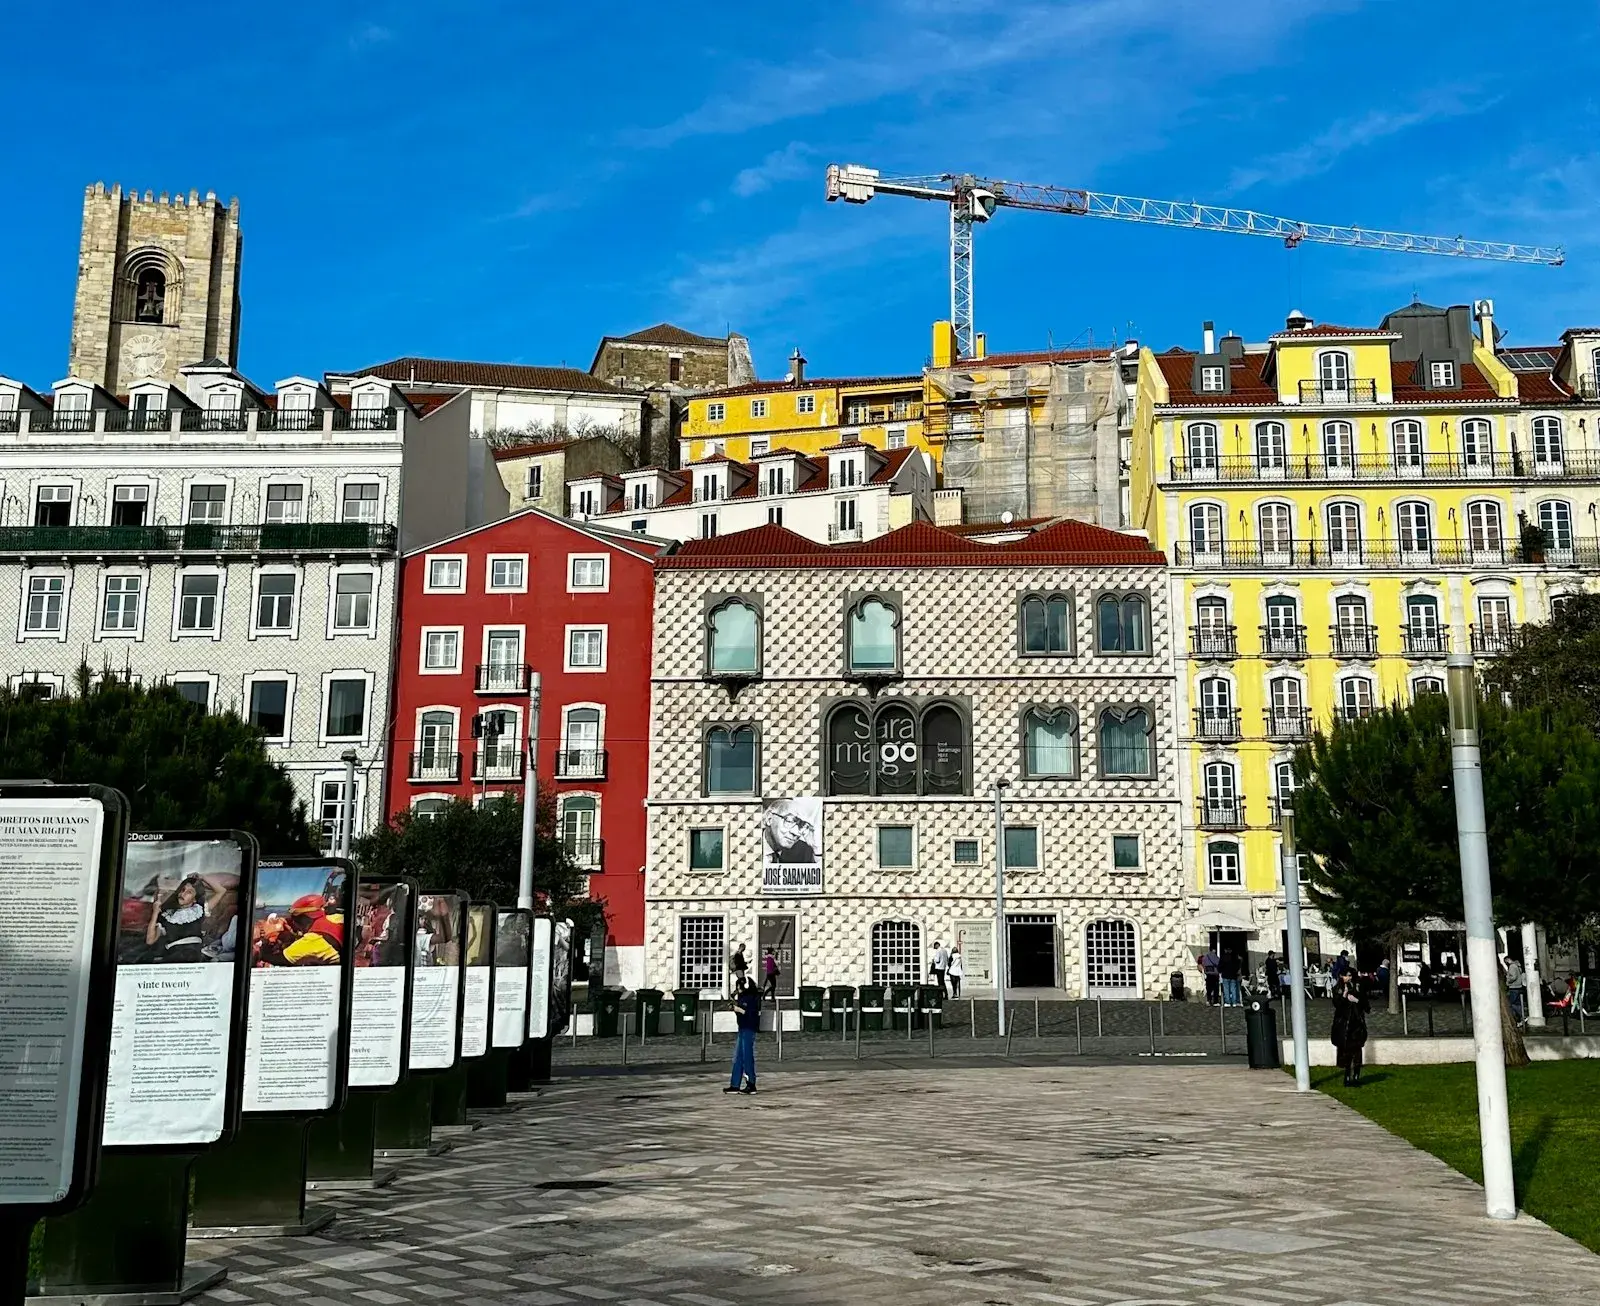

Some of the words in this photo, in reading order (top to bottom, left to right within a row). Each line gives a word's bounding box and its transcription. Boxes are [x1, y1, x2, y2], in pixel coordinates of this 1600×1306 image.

[854, 713, 914, 739] Sara
[836, 740, 917, 775] mago
[43, 816, 89, 824] HUMANOS
[4, 826, 39, 834] HUMAN
[763, 864, 781, 886] JOSÉ
[782, 868, 821, 885] SARAMAGO
[137, 981, 159, 989] vinte
[161, 980, 192, 989] twenty
